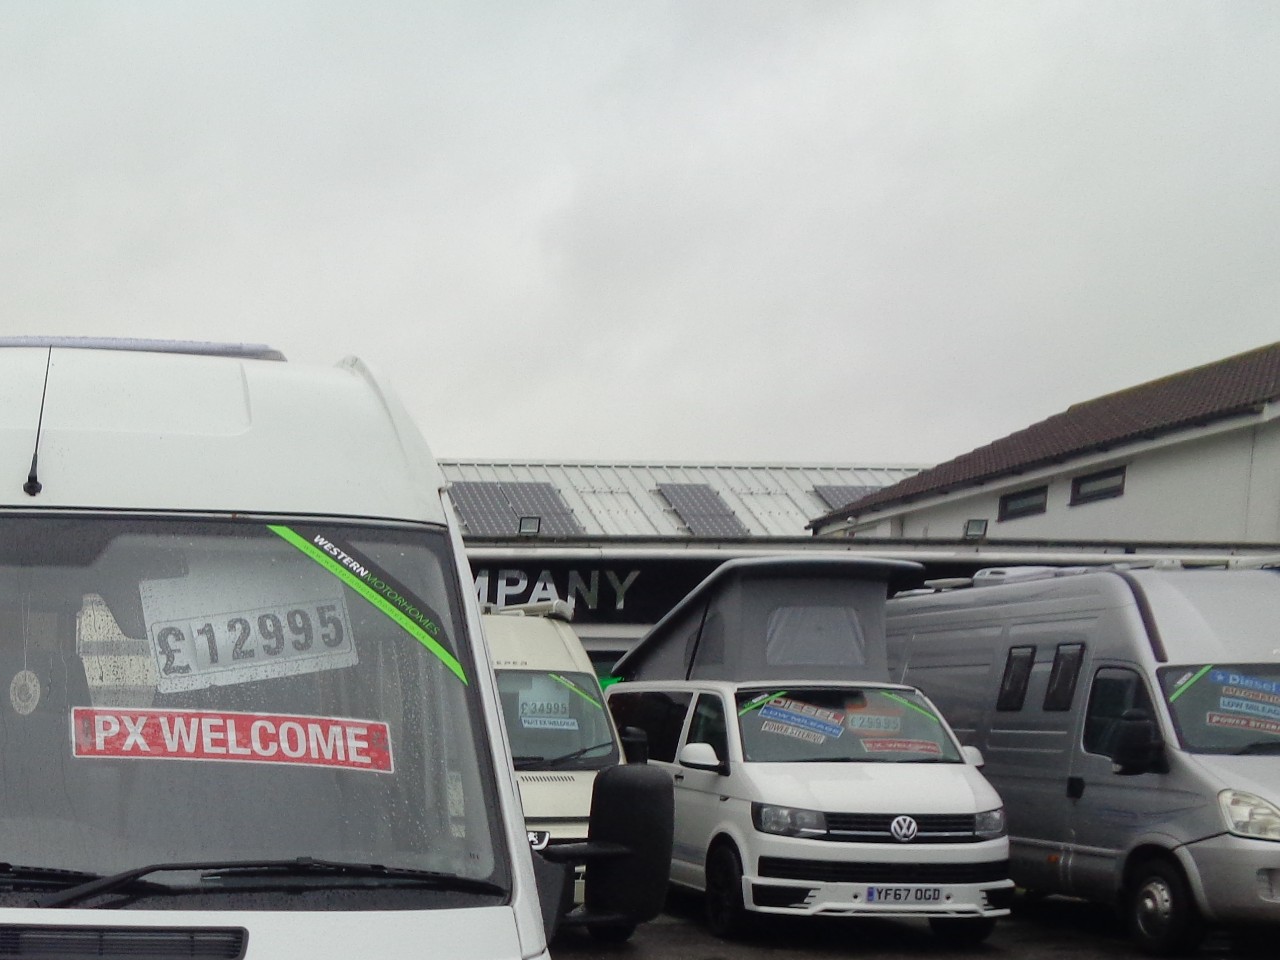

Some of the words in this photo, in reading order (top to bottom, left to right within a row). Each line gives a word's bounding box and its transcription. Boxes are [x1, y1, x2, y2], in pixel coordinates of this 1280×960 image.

[157, 604, 345, 676] £12995
[93, 714, 151, 752] PX
[158, 718, 373, 764] WELCOME
[876, 888, 911, 901] YF67
